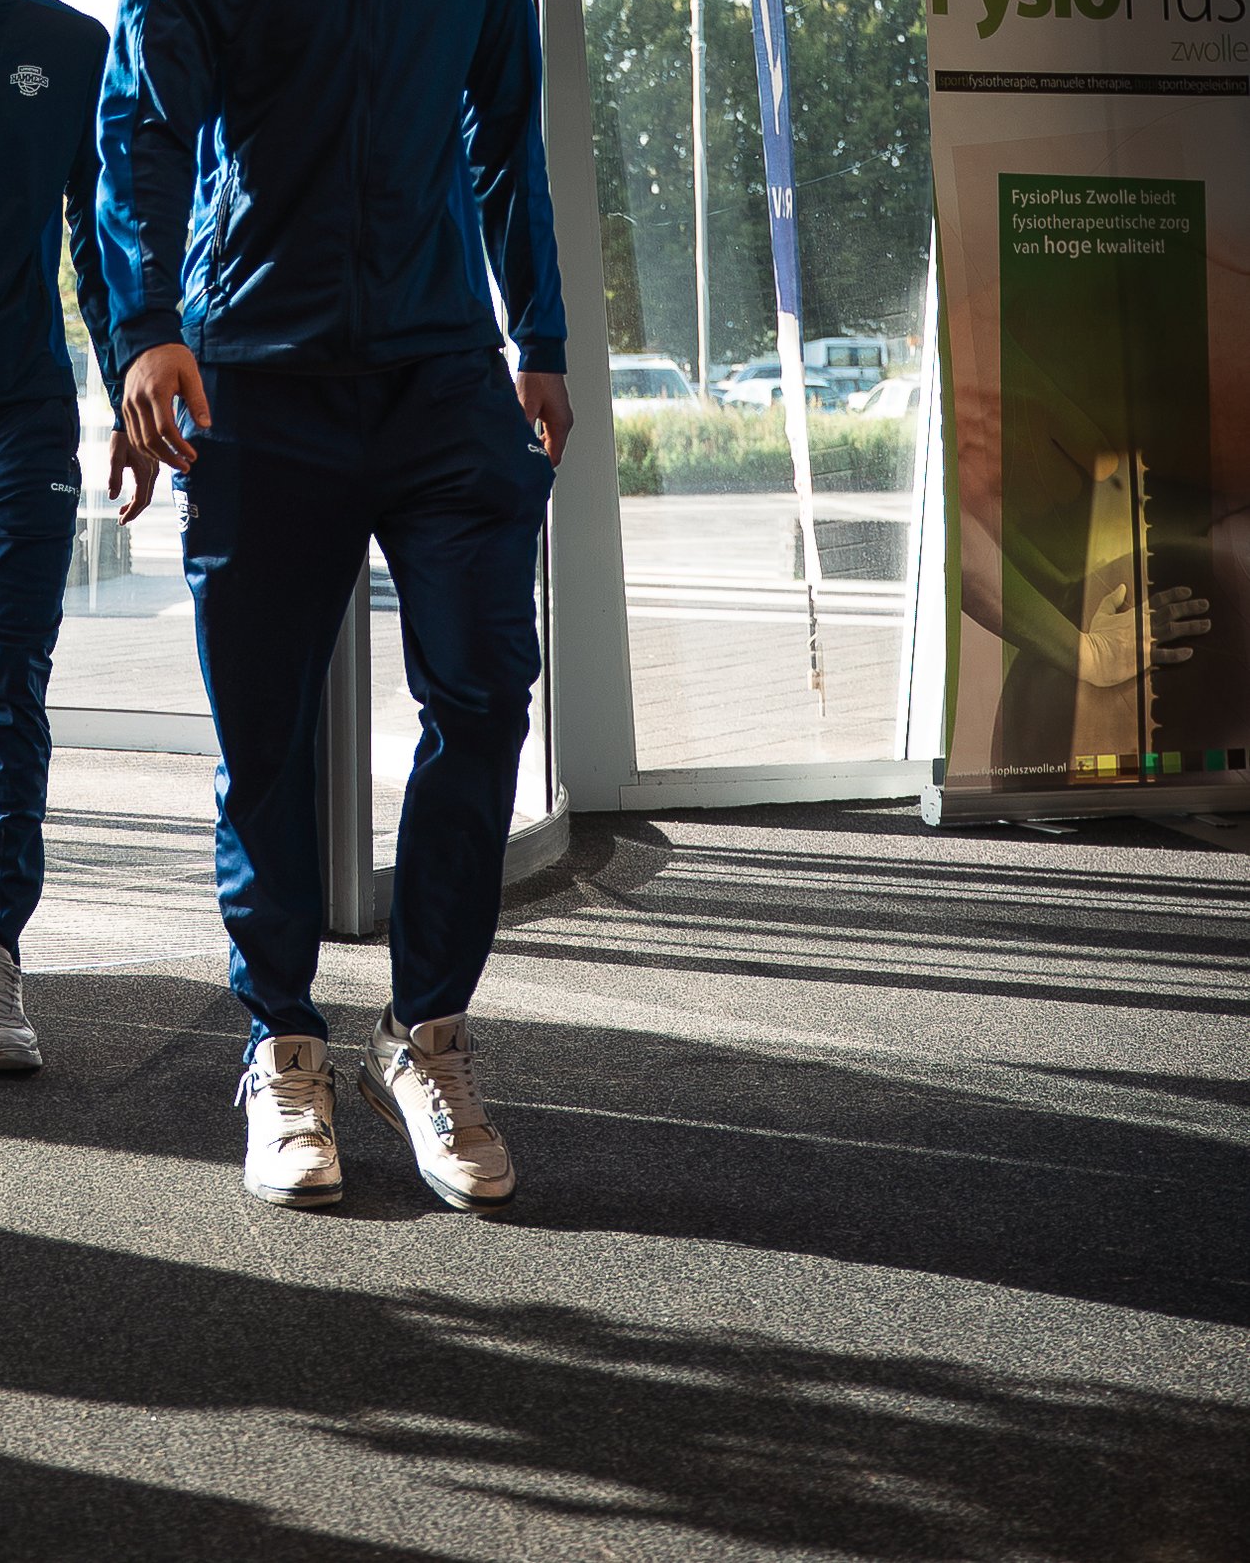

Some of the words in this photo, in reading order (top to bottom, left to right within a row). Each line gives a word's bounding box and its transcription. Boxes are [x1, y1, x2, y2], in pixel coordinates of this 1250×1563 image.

[1170, 34, 1248, 63] zwolle
[1040, 77, 1085, 89] manuele
[1012, 189, 1082, 208] FysioPlus
[1086, 190, 1137, 205] Zwolle
[1141, 190, 1177, 205] biedt
[1012, 213, 1156, 233] fysiotherapeutische
[1159, 217, 1190, 234] zorg
[1013, 242, 1040, 254] van
[1044, 235, 1092, 258] hoge
[1097, 239, 1166, 254] kwaliteit!
